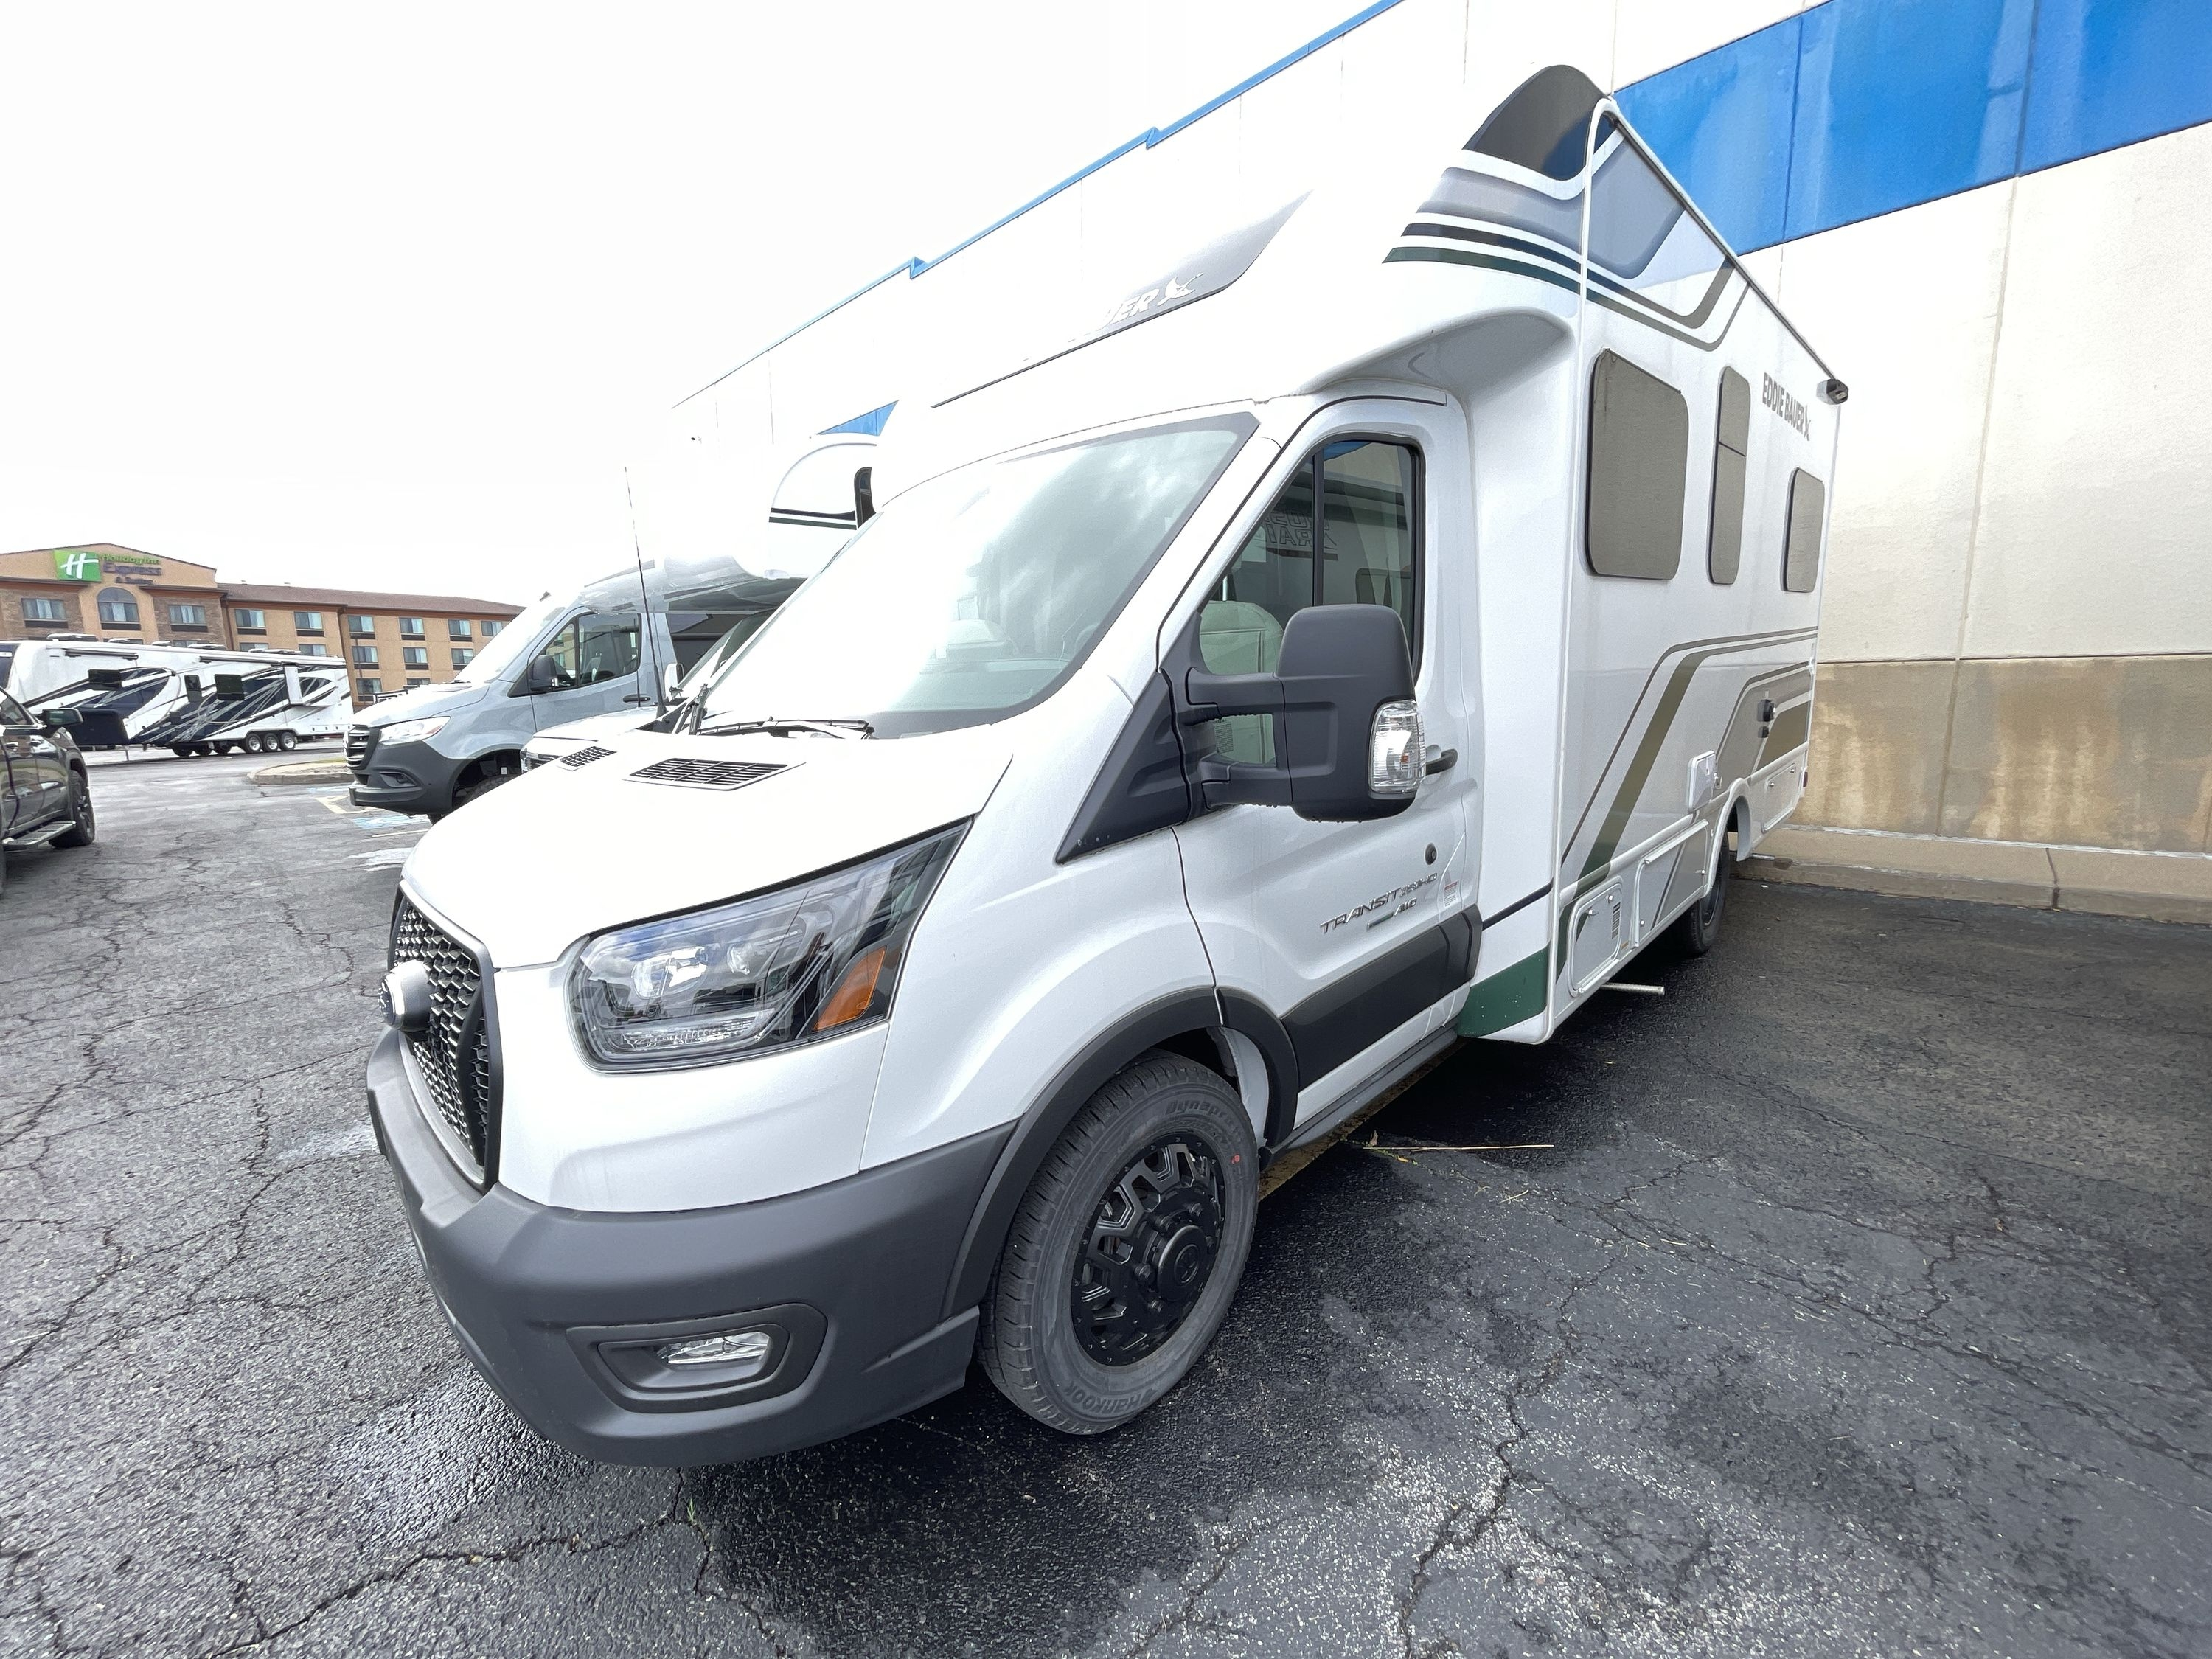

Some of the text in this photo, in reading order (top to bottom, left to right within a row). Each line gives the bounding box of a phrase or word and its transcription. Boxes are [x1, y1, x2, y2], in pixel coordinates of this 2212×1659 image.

[1761, 372, 1805, 434] EDDIE BAUER
[102, 554, 161, 565] Holiday Inn
[1320, 887, 1401, 934] TRANSIT
